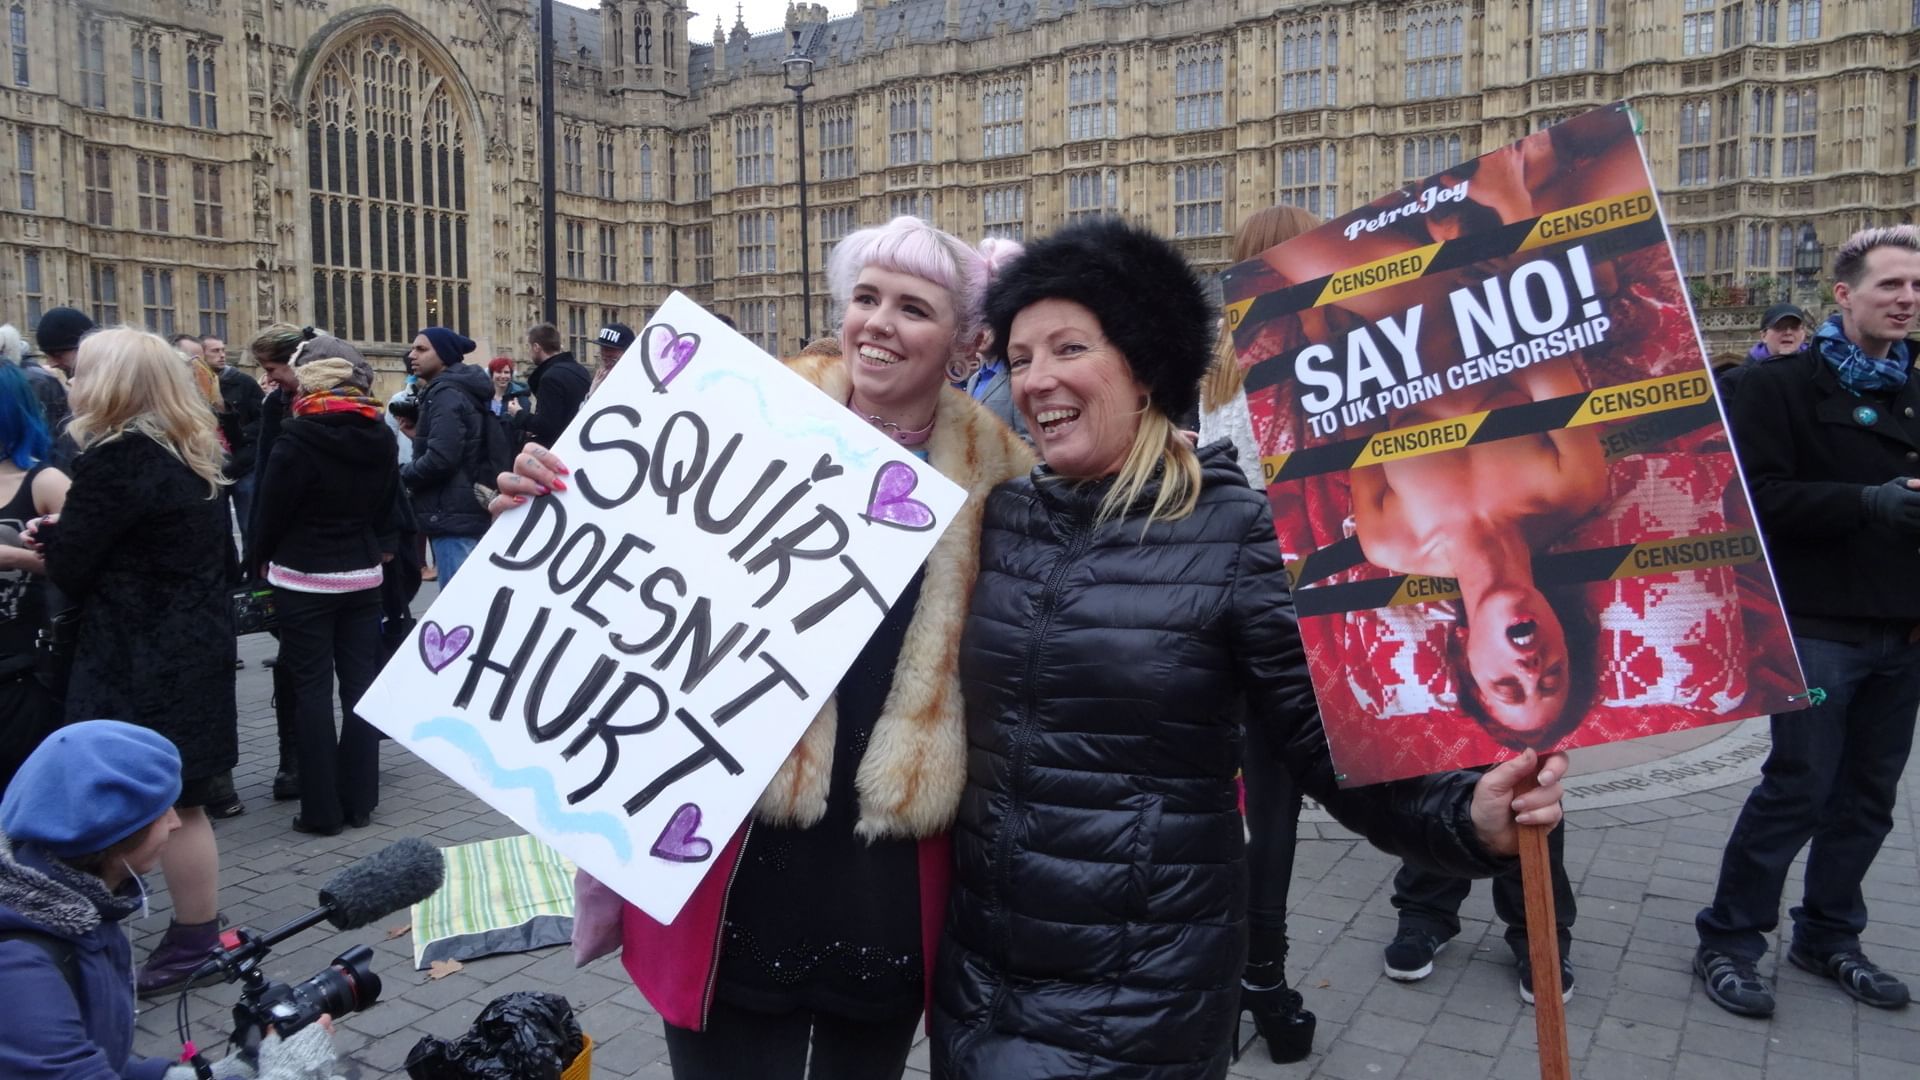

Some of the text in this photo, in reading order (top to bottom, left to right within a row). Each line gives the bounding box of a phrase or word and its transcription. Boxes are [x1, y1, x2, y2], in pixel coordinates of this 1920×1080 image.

[1539, 193, 1654, 240] CENSORED
[1331, 254, 1423, 296] CENSORED
[1294, 244, 1602, 415] SAY NO!
[1307, 315, 1612, 439] TO UK PORN CENSORSHIP
[1589, 376, 1709, 416] CENSORED
[1371, 422, 1468, 457] CENSORED
[574, 404, 889, 633] SQUIRT
[1633, 537, 1758, 570] CENSORED
[489, 493, 809, 727] DOESN'T
[453, 586, 744, 816] HURT
